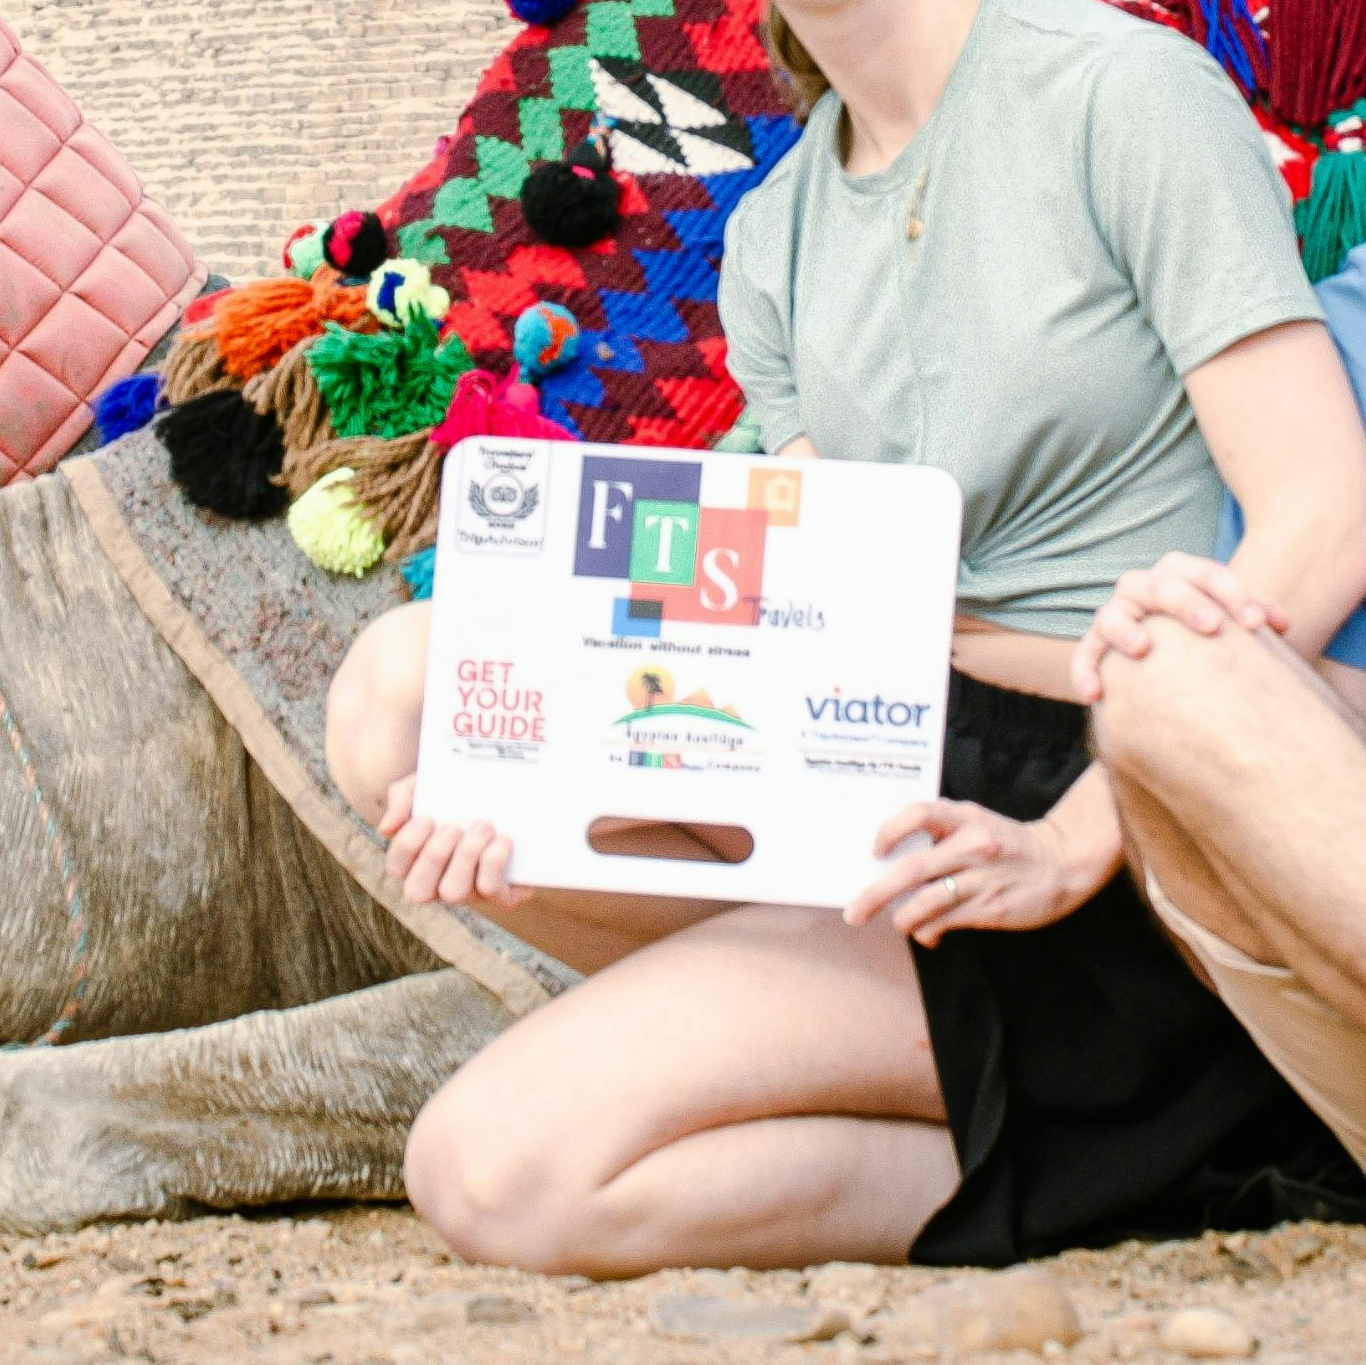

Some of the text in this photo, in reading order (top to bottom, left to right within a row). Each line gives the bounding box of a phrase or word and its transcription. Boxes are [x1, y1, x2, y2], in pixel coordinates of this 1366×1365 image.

[741, 596, 828, 630] Travels
[457, 659, 515, 684] GET
[457, 685, 543, 713] YOUR
[805, 686, 931, 728] viator
[453, 711, 547, 742] GUIDE
